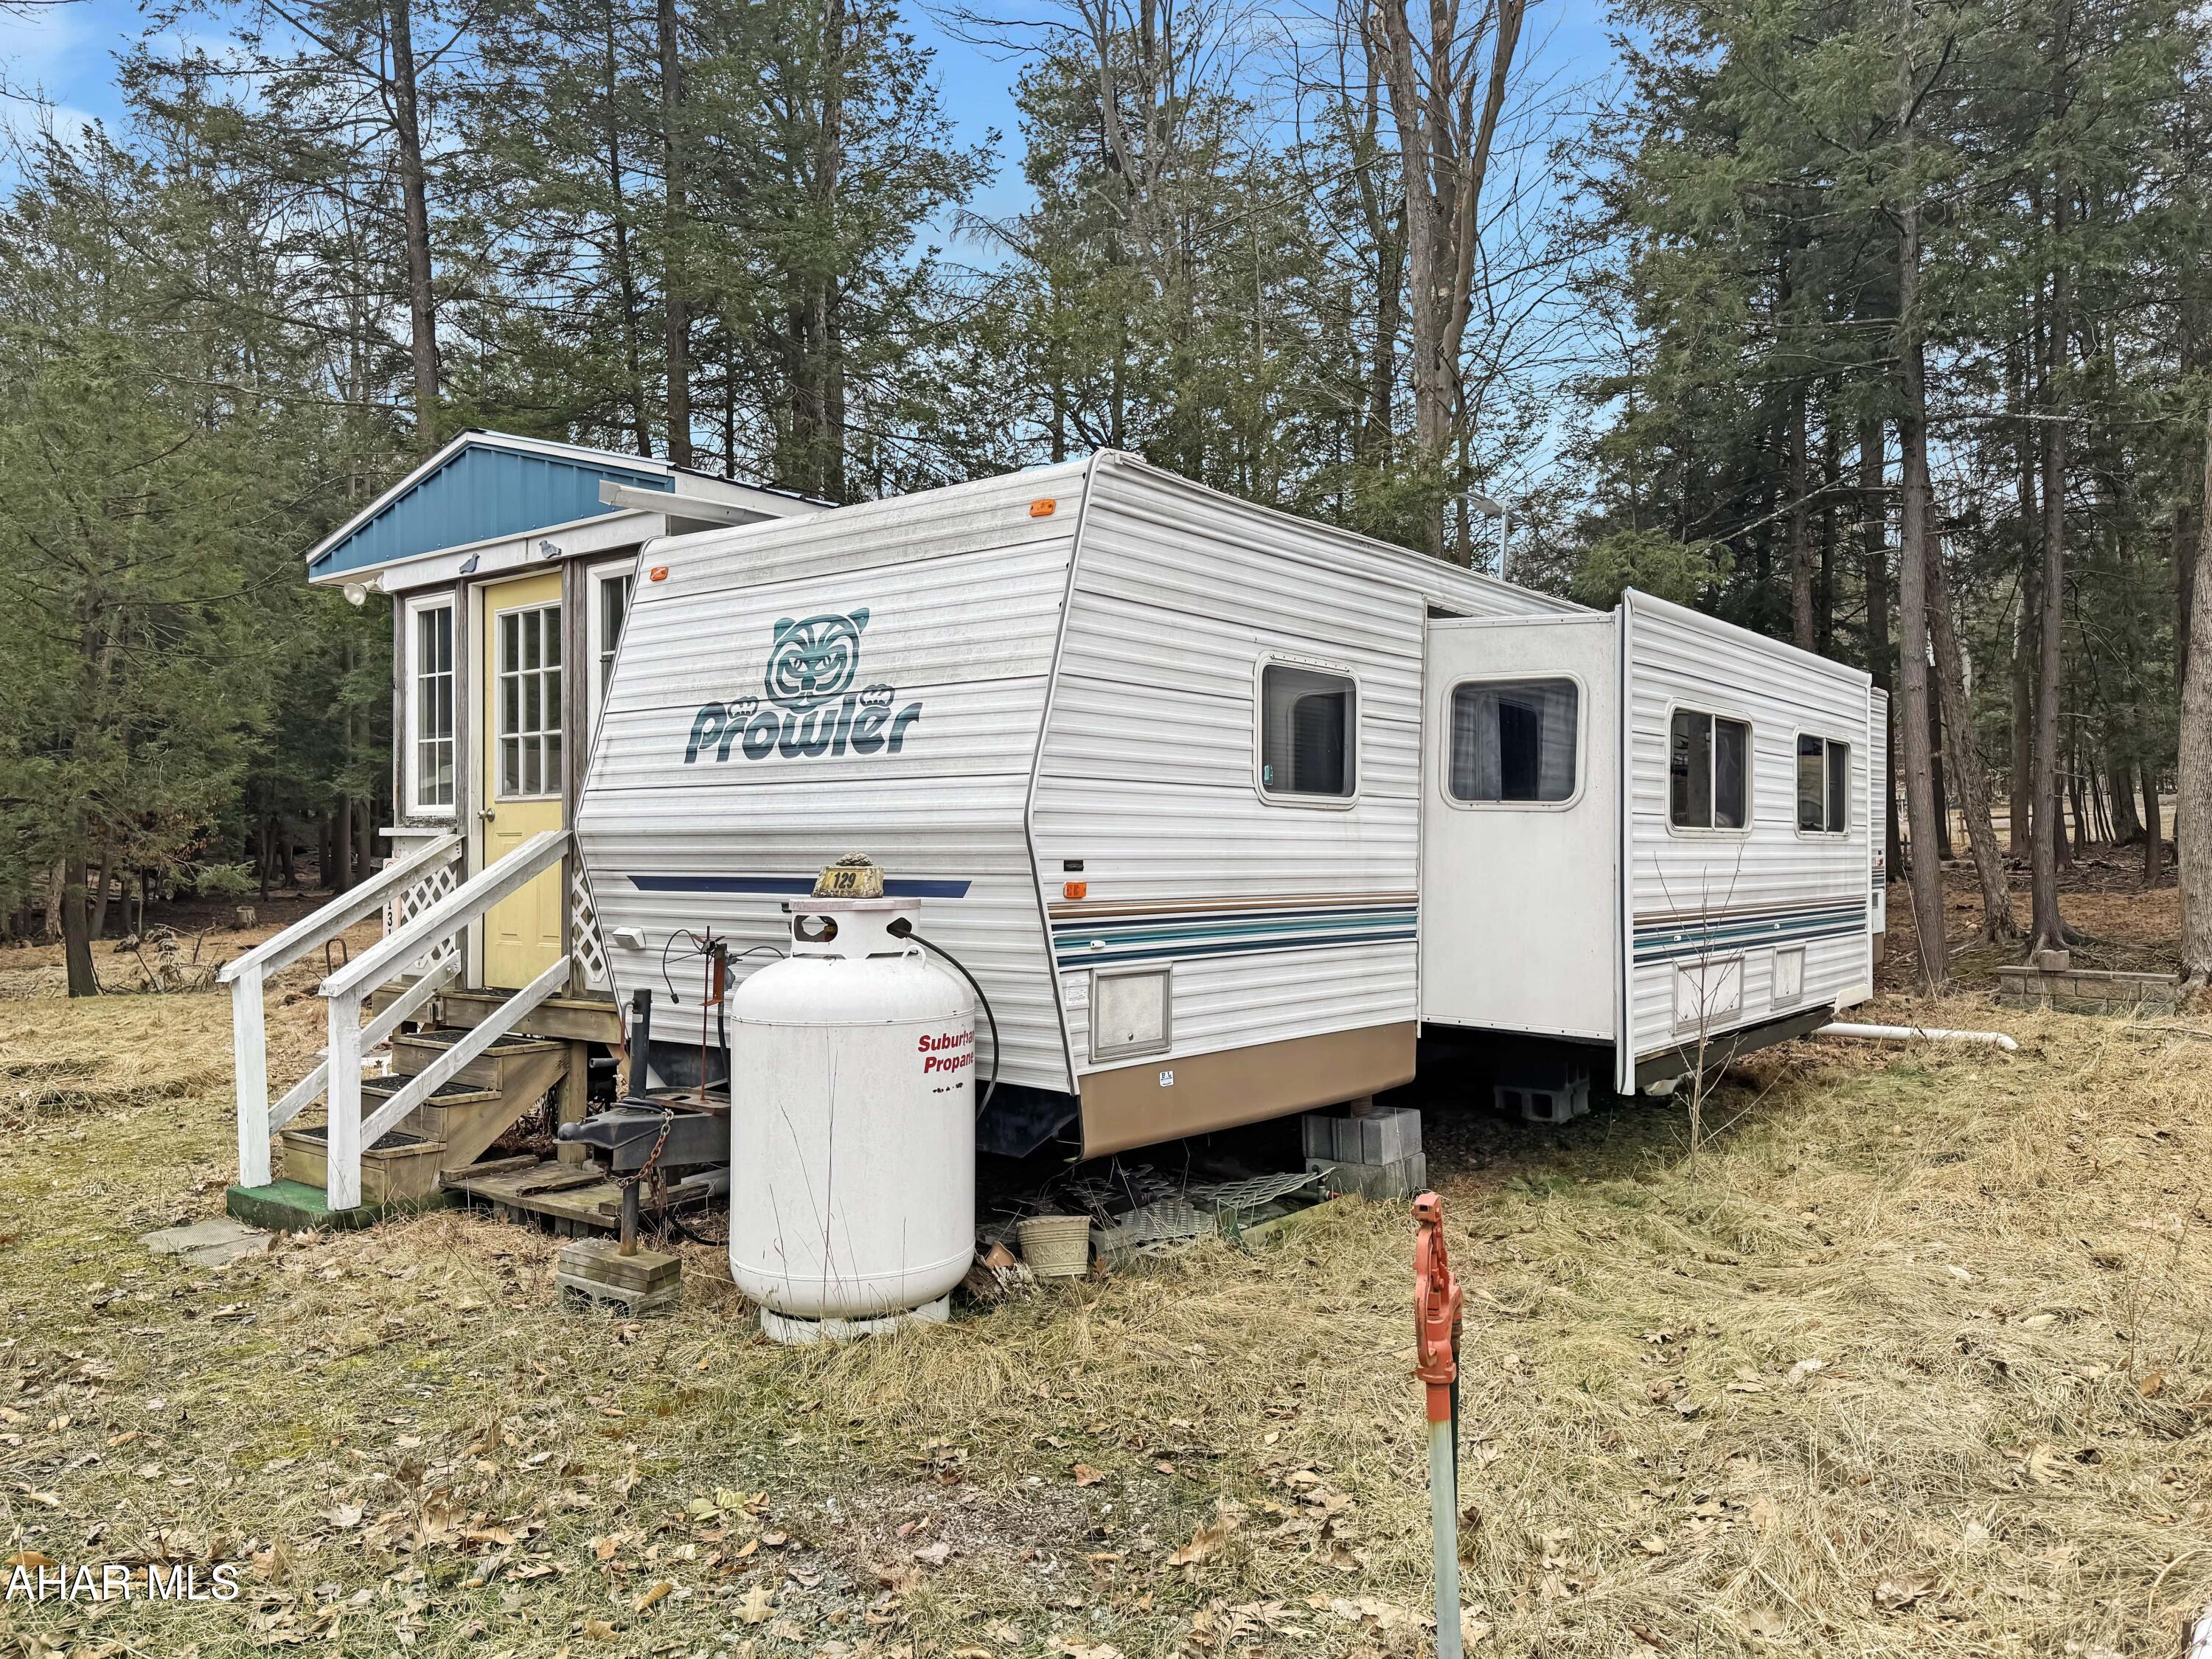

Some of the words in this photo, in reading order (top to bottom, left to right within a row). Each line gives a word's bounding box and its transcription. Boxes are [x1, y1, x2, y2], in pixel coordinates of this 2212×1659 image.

[684, 694, 922, 764] Prowler
[834, 872, 857, 888] 129
[924, 1051, 974, 1074] Propane
